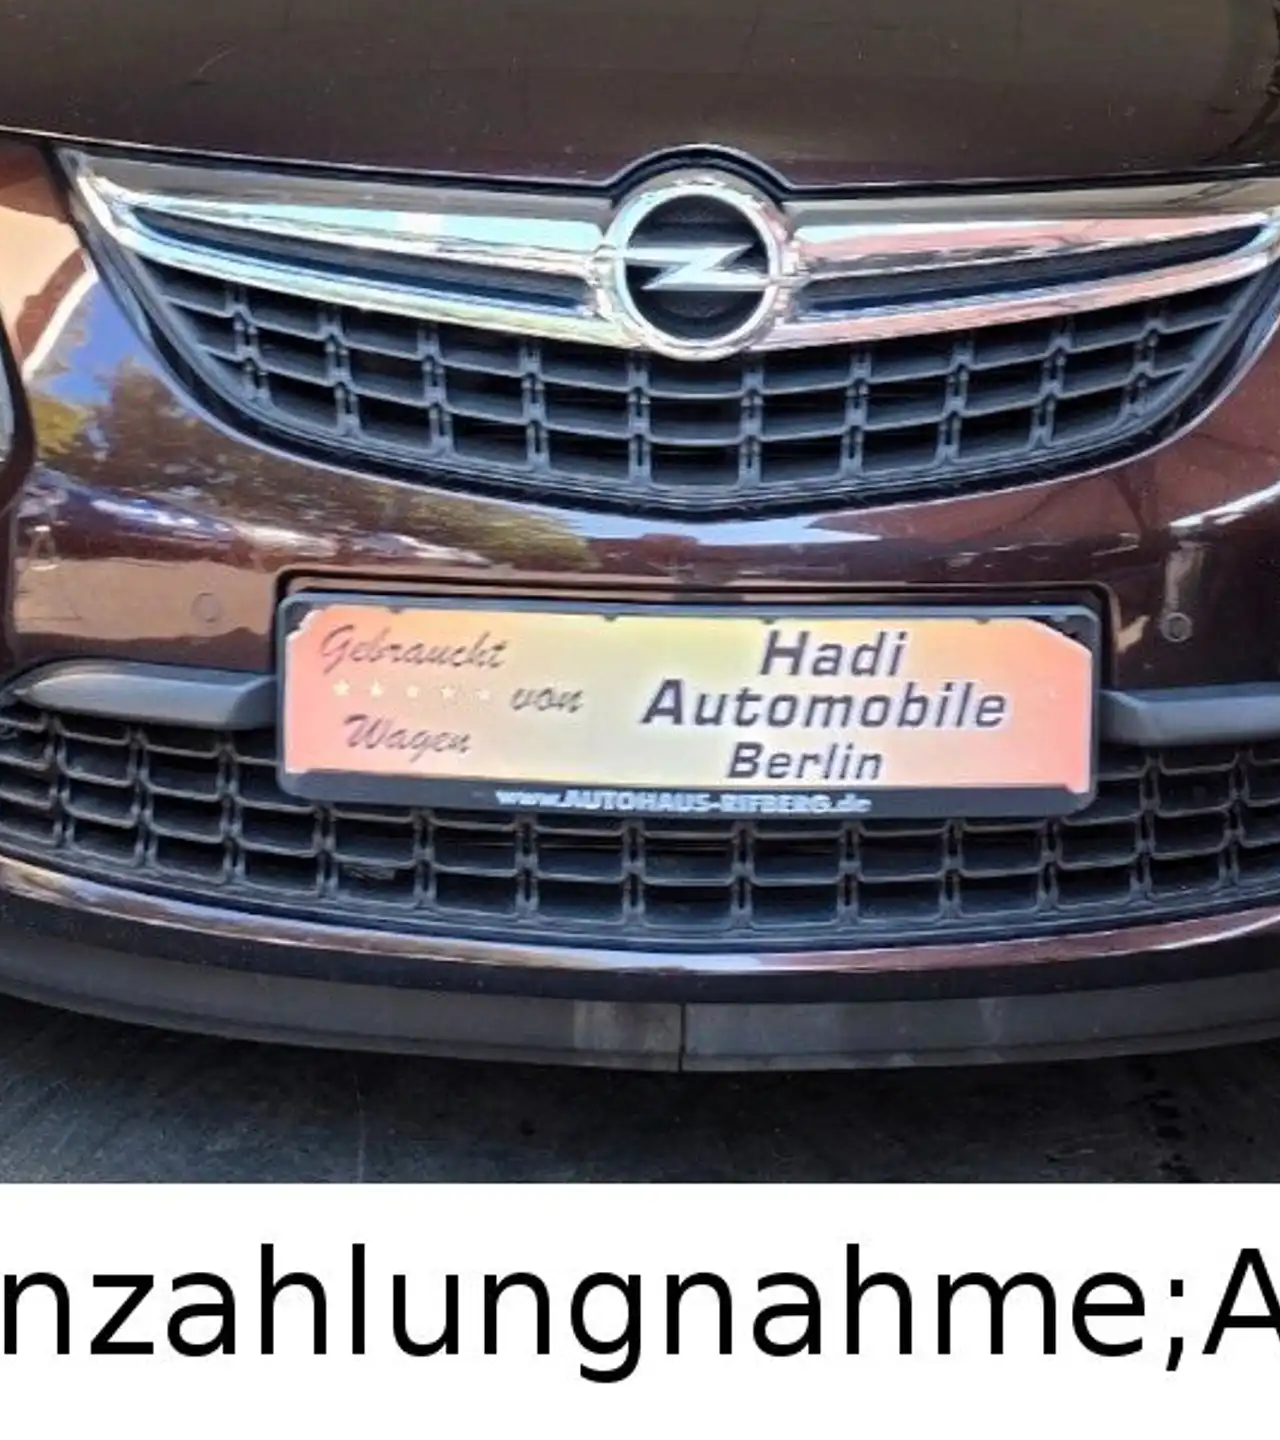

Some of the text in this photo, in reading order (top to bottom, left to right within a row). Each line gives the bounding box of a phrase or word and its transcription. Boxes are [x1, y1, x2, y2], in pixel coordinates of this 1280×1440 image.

[320, 624, 507, 674] Gebraucht
[760, 630, 909, 677] Hadi
[510, 685, 584, 713] von
[640, 678, 1007, 728] Automobile
[343, 713, 471, 762] Wagen
[726, 740, 884, 782] Berlin
